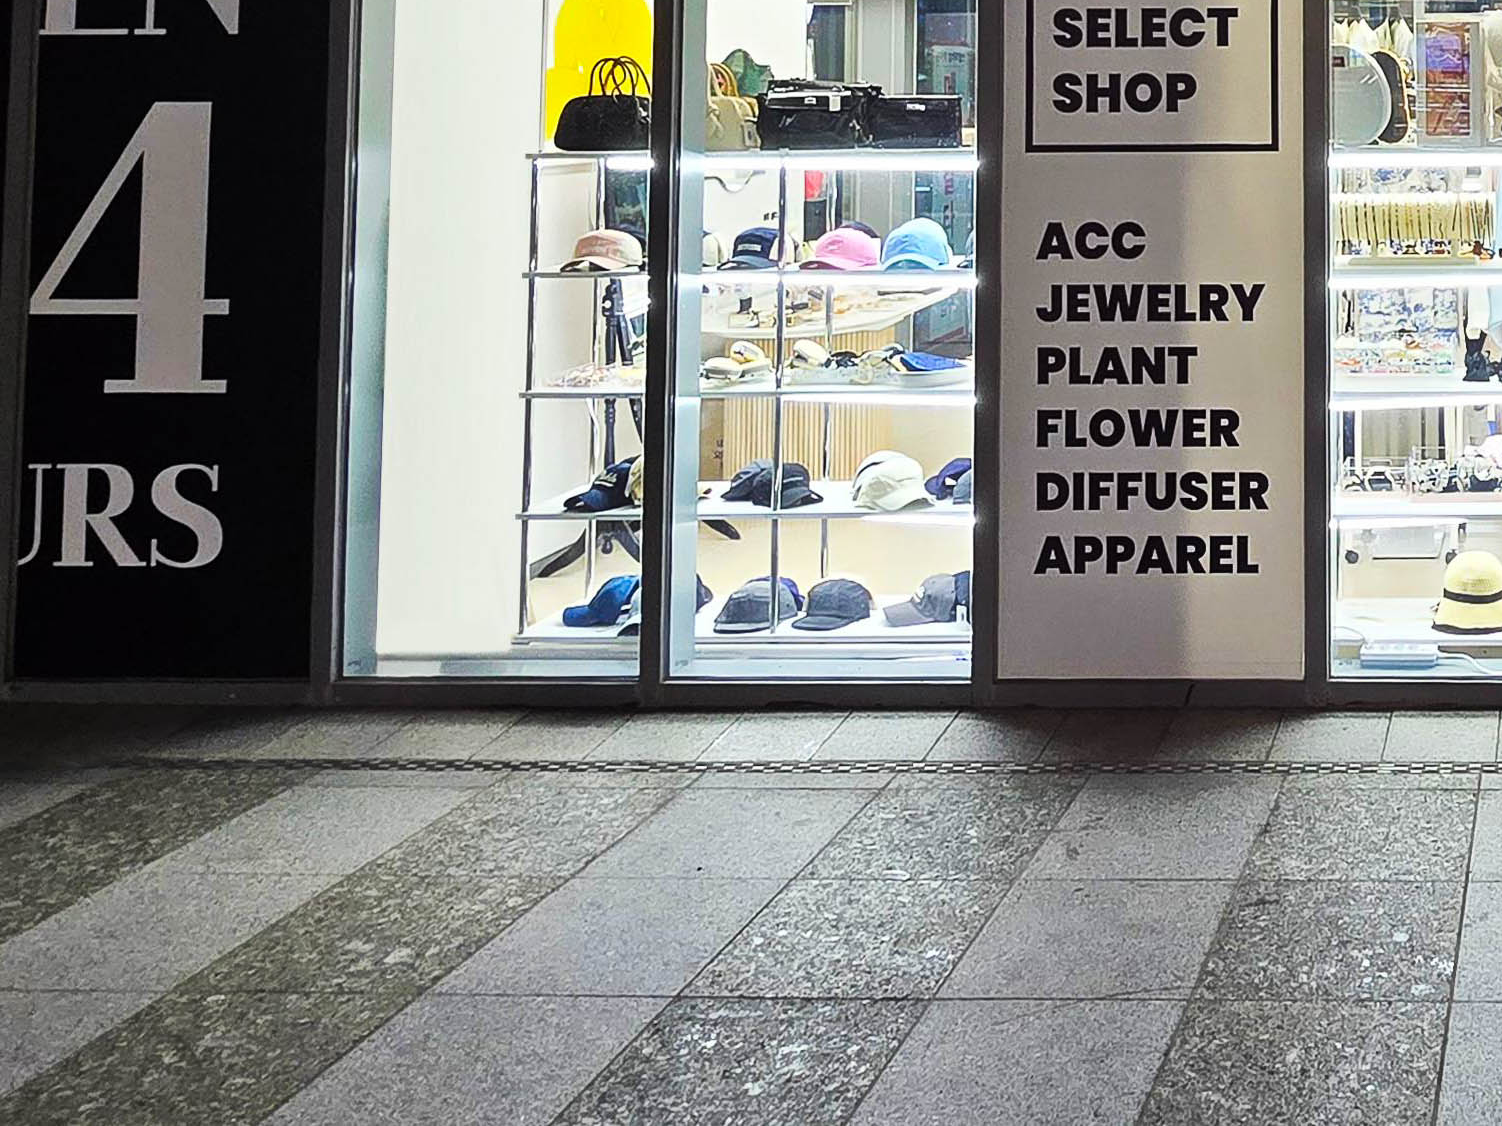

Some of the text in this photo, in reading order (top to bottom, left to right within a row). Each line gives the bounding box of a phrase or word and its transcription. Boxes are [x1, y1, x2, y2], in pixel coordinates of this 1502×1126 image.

[1052, 7, 1239, 48] SELECT
[1052, 72, 1197, 114] SHOP
[1035, 221, 1146, 260] ACC
[1035, 283, 1266, 323] JEWELRY
[1037, 346, 1198, 385] PLANT
[1036, 408, 1240, 448] FLOWER
[1036, 471, 1269, 511] DIFFUSER
[1033, 535, 1259, 575] APPAREL
